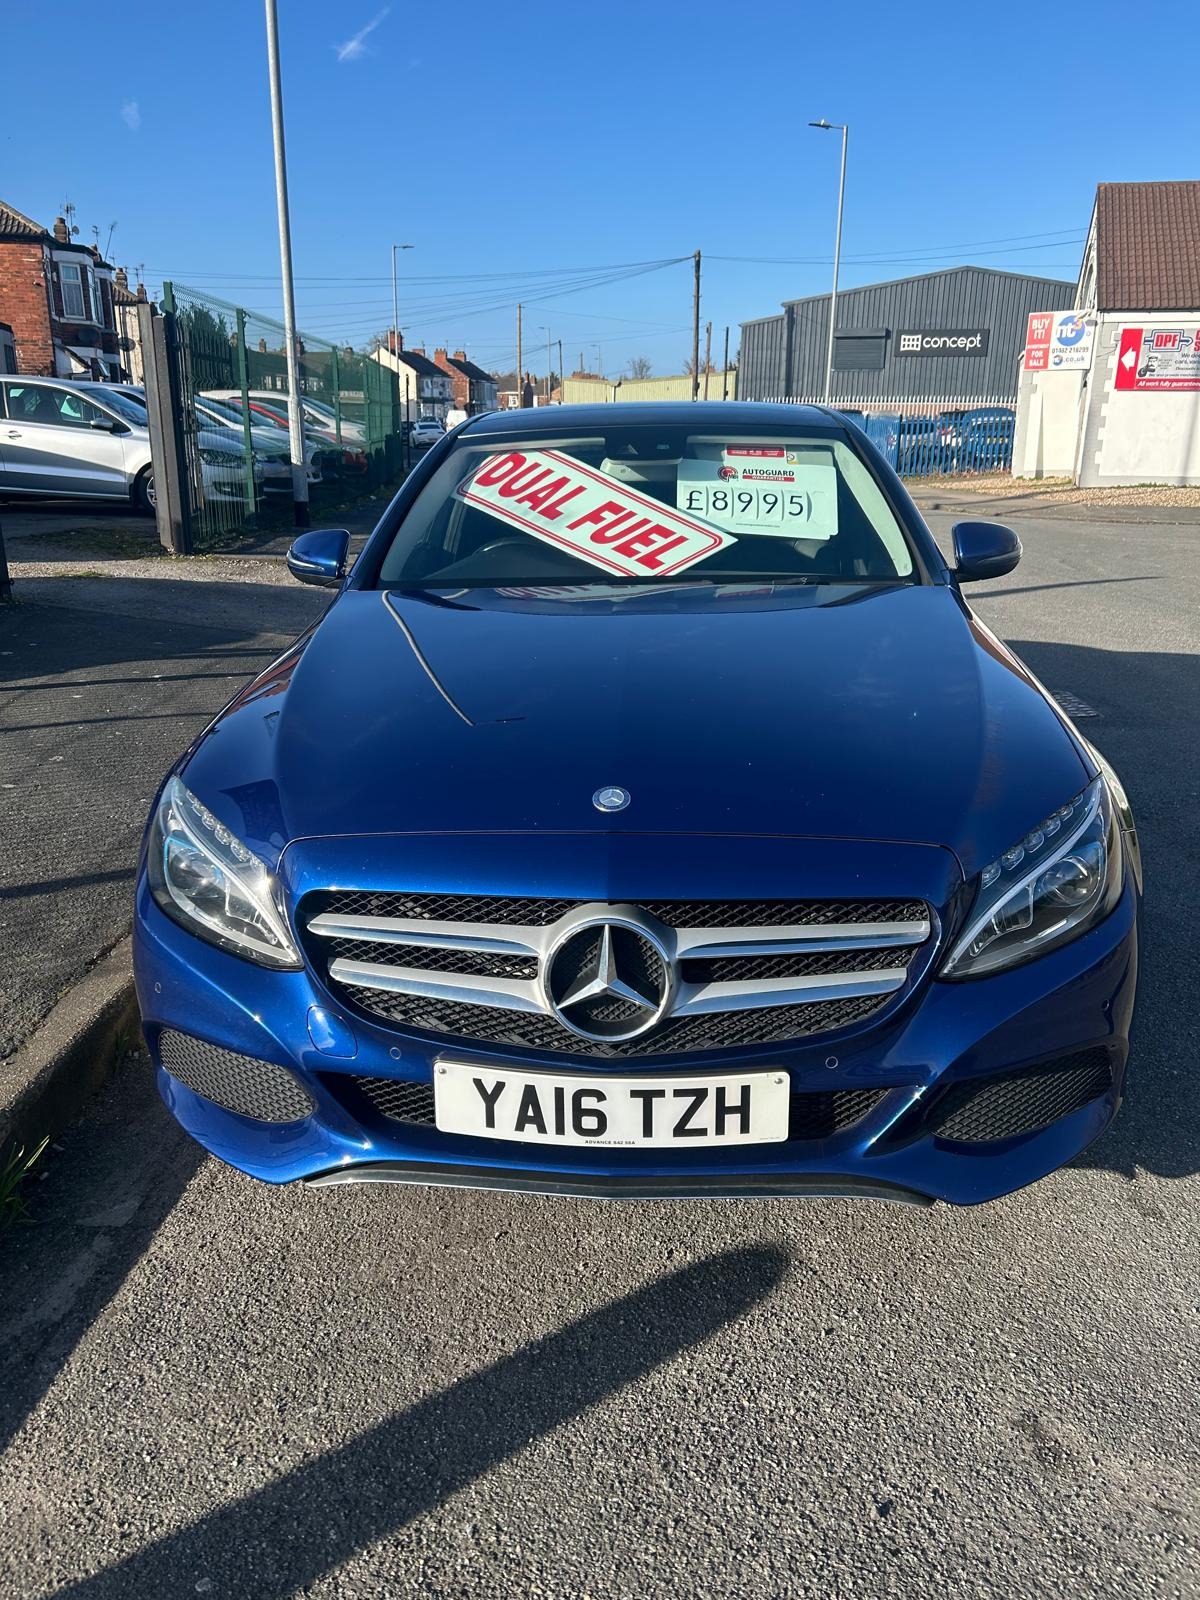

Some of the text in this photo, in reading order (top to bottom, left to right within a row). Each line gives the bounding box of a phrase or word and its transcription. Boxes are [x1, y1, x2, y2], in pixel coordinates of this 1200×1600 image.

[1032, 319, 1050, 330] BUY
[1034, 330, 1045, 339] IT!
[922, 333, 982, 351] concept
[1155, 334, 1179, 348] DPF
[1031, 350, 1044, 358] FOR
[1160, 380, 1171, 388] fully
[742, 468, 795, 477] AUTOGUARD
[686, 490, 804, 517] £8995
[475, 452, 689, 570] DUAL FUEL
[472, 1077, 752, 1139] YA16 TZH
